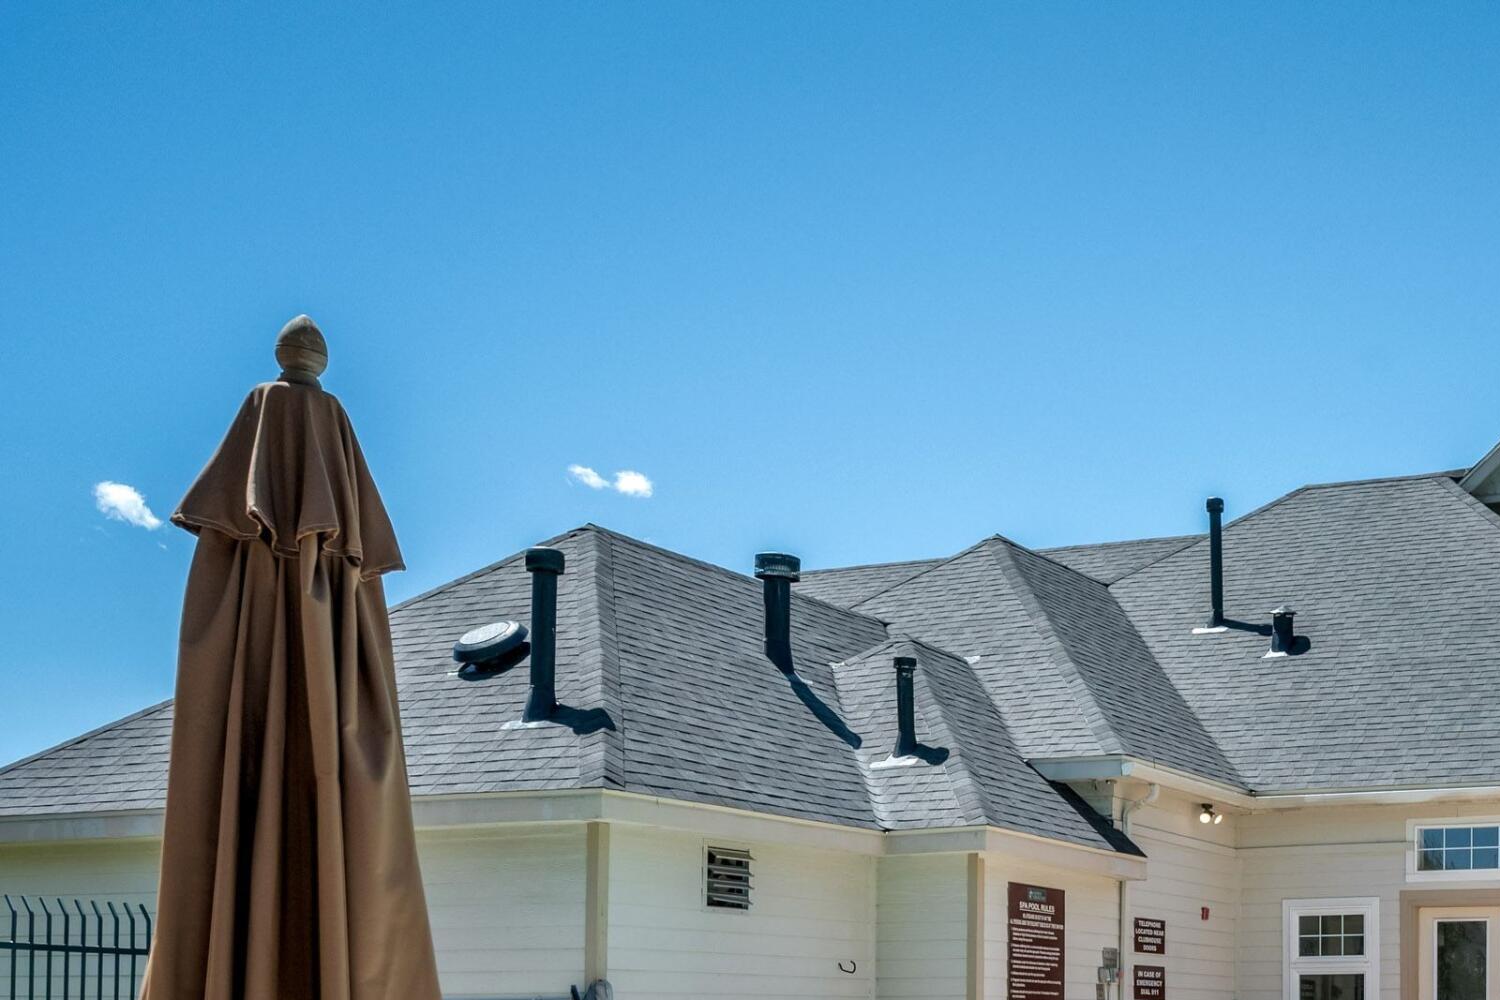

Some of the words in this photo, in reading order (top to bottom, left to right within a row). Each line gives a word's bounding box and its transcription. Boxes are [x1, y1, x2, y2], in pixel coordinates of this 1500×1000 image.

[1138, 920, 1162, 929] TELEPHONE
[1135, 928, 1153, 936] LOCATED
[1138, 936, 1162, 944] CLUBHOUSE
[1136, 979, 1163, 987] EMERGENCY
